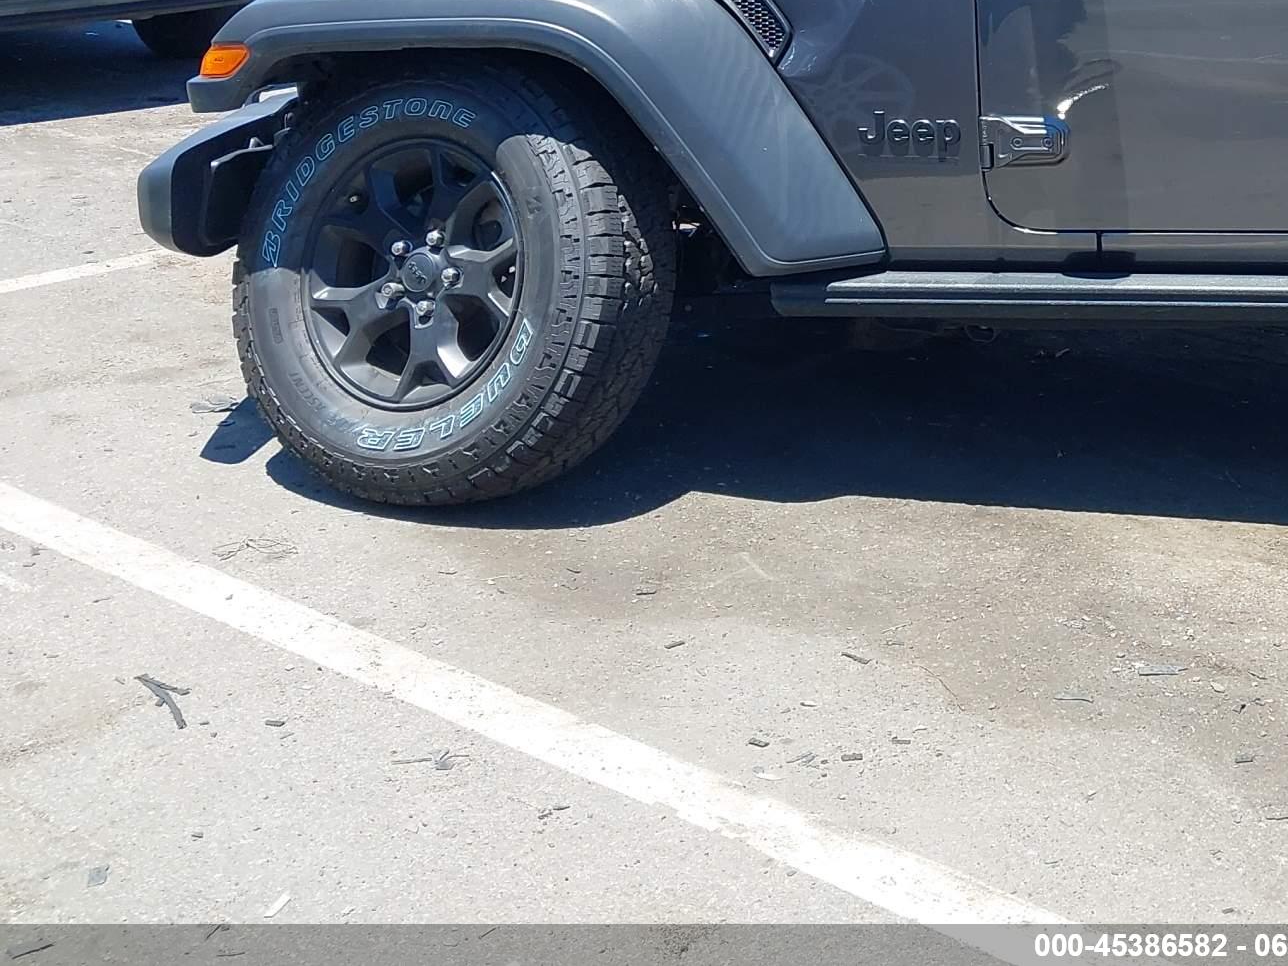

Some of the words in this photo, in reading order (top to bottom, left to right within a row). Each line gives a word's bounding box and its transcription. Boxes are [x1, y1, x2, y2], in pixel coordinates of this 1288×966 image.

[263, 97, 477, 268] BRIDGESTONE
[857, 110, 961, 163] Jeep
[356, 318, 535, 453] DUELER
